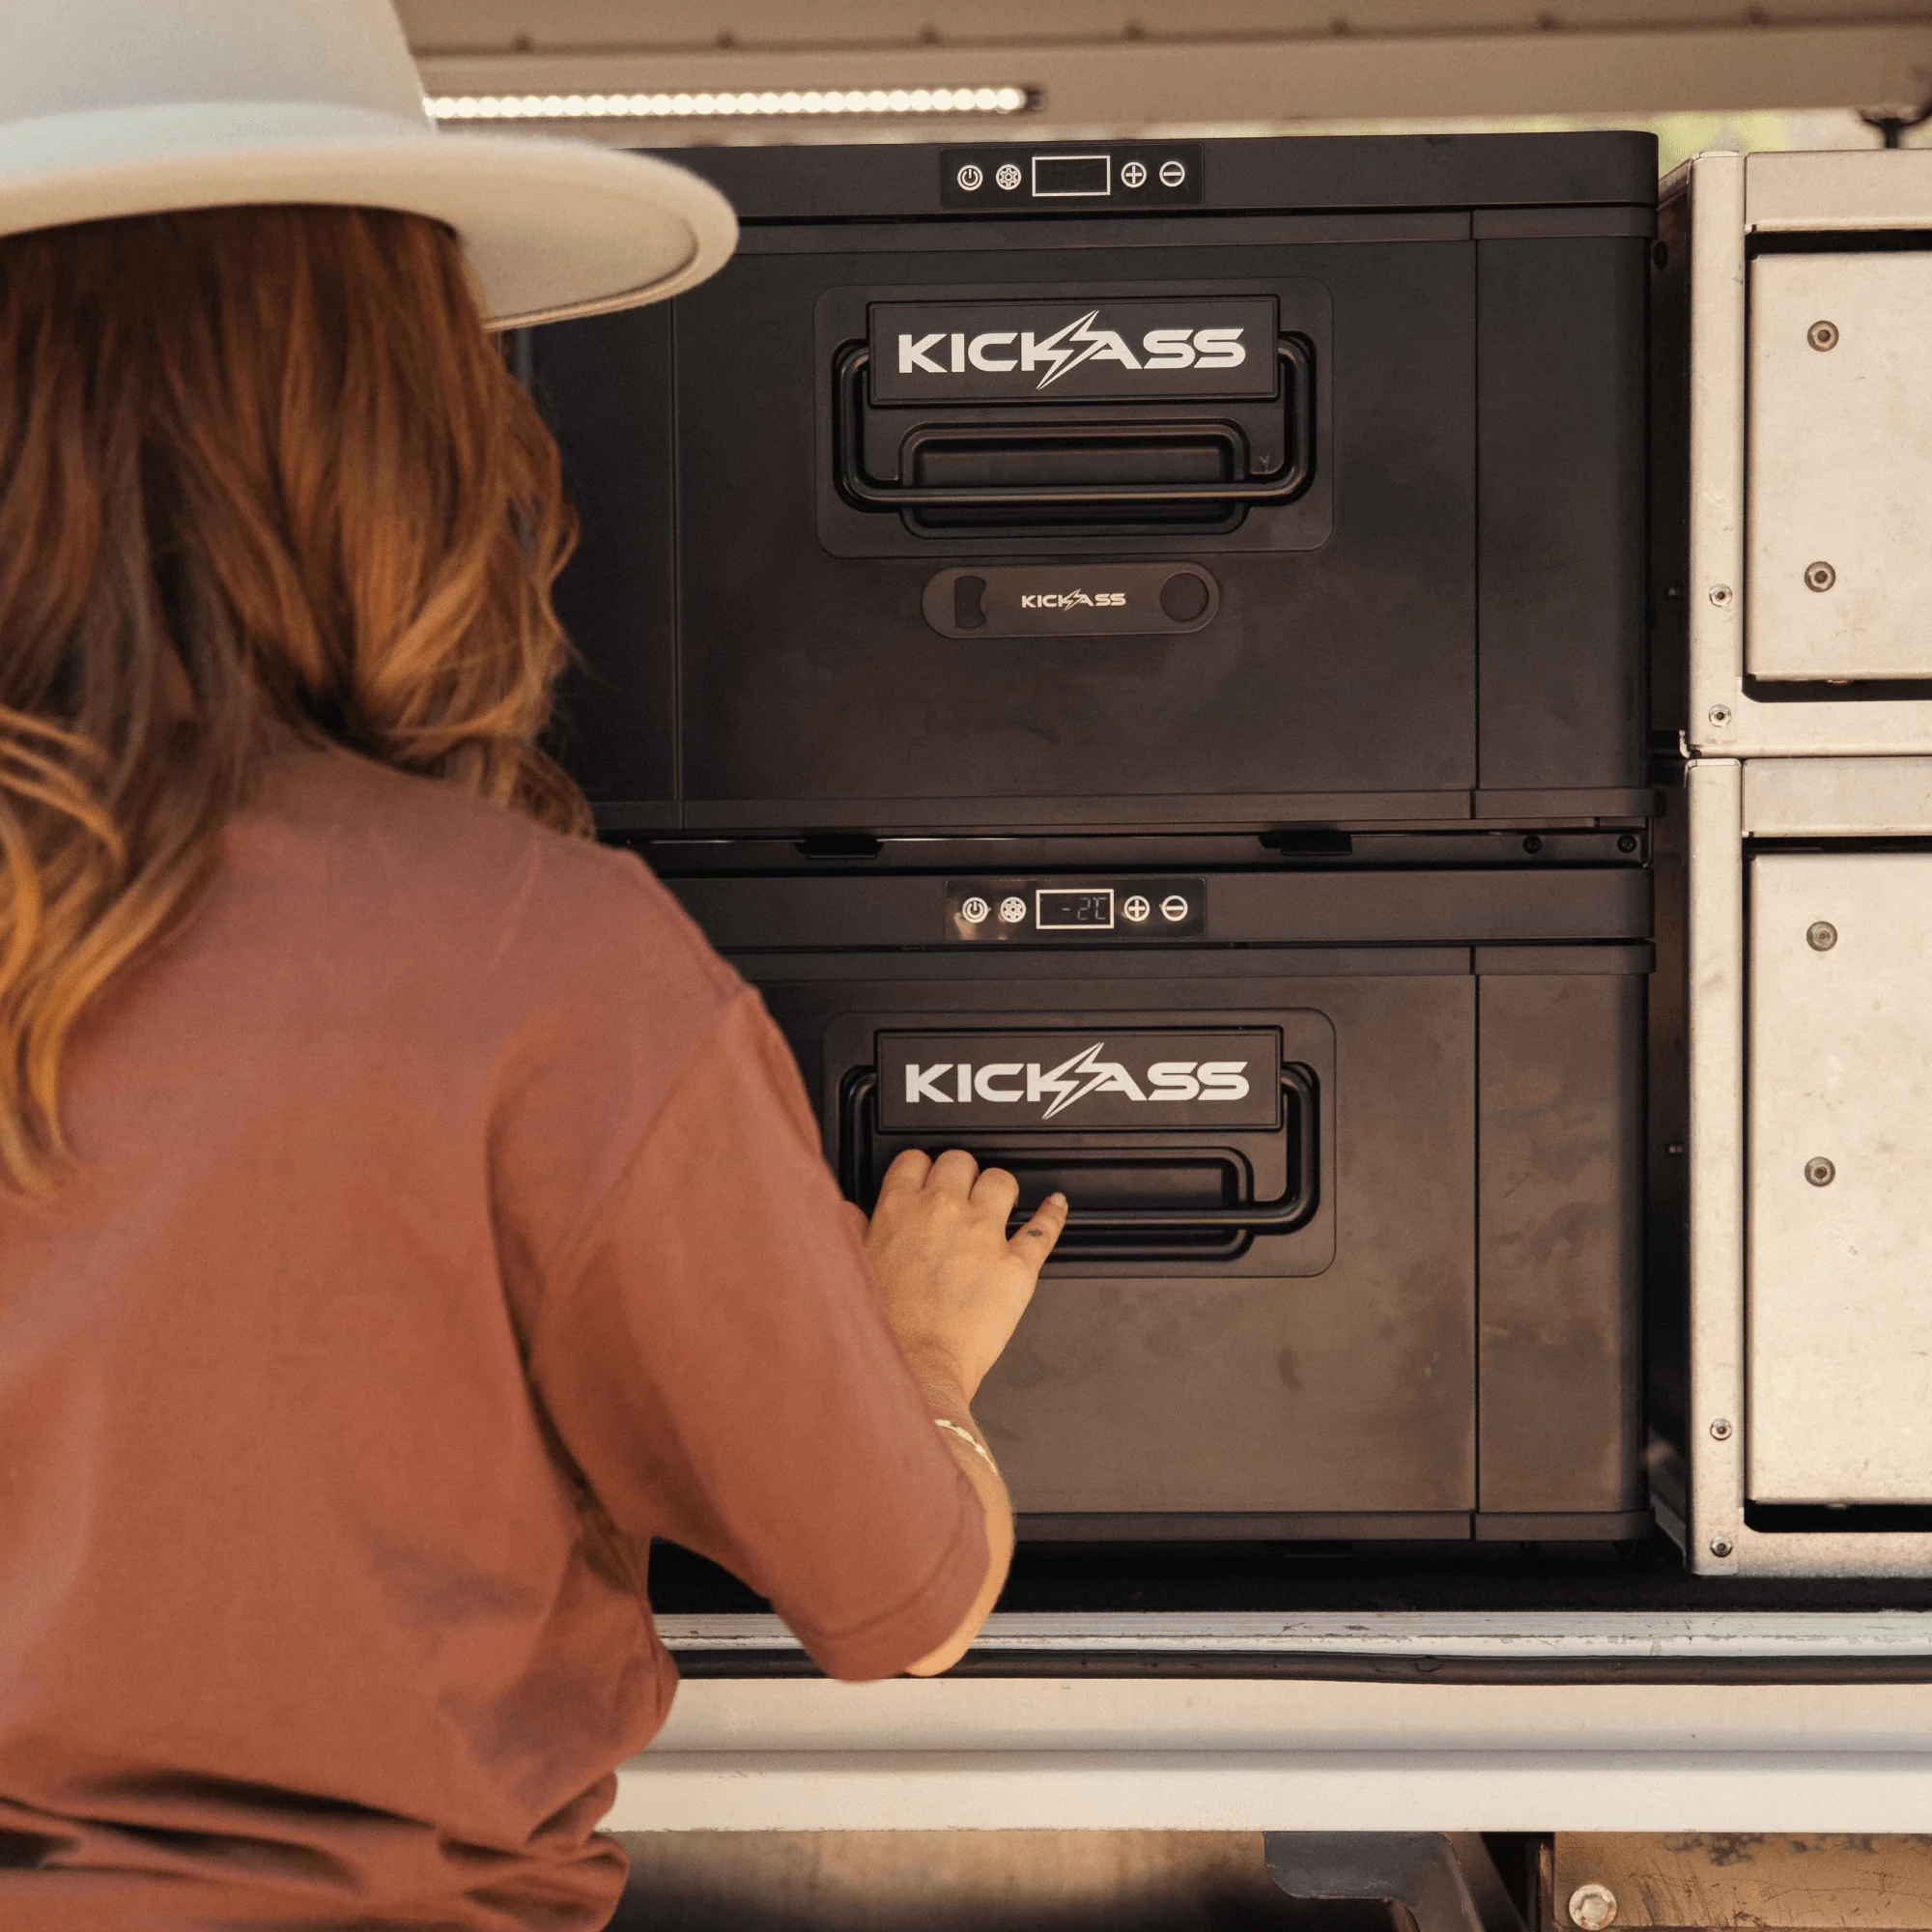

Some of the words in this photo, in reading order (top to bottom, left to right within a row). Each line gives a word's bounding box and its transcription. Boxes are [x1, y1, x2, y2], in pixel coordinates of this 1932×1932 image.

[898, 309, 1246, 390] KICKASS
[1021, 588, 1126, 611] KICKASS
[905, 1042, 1249, 1120] KICKASS
